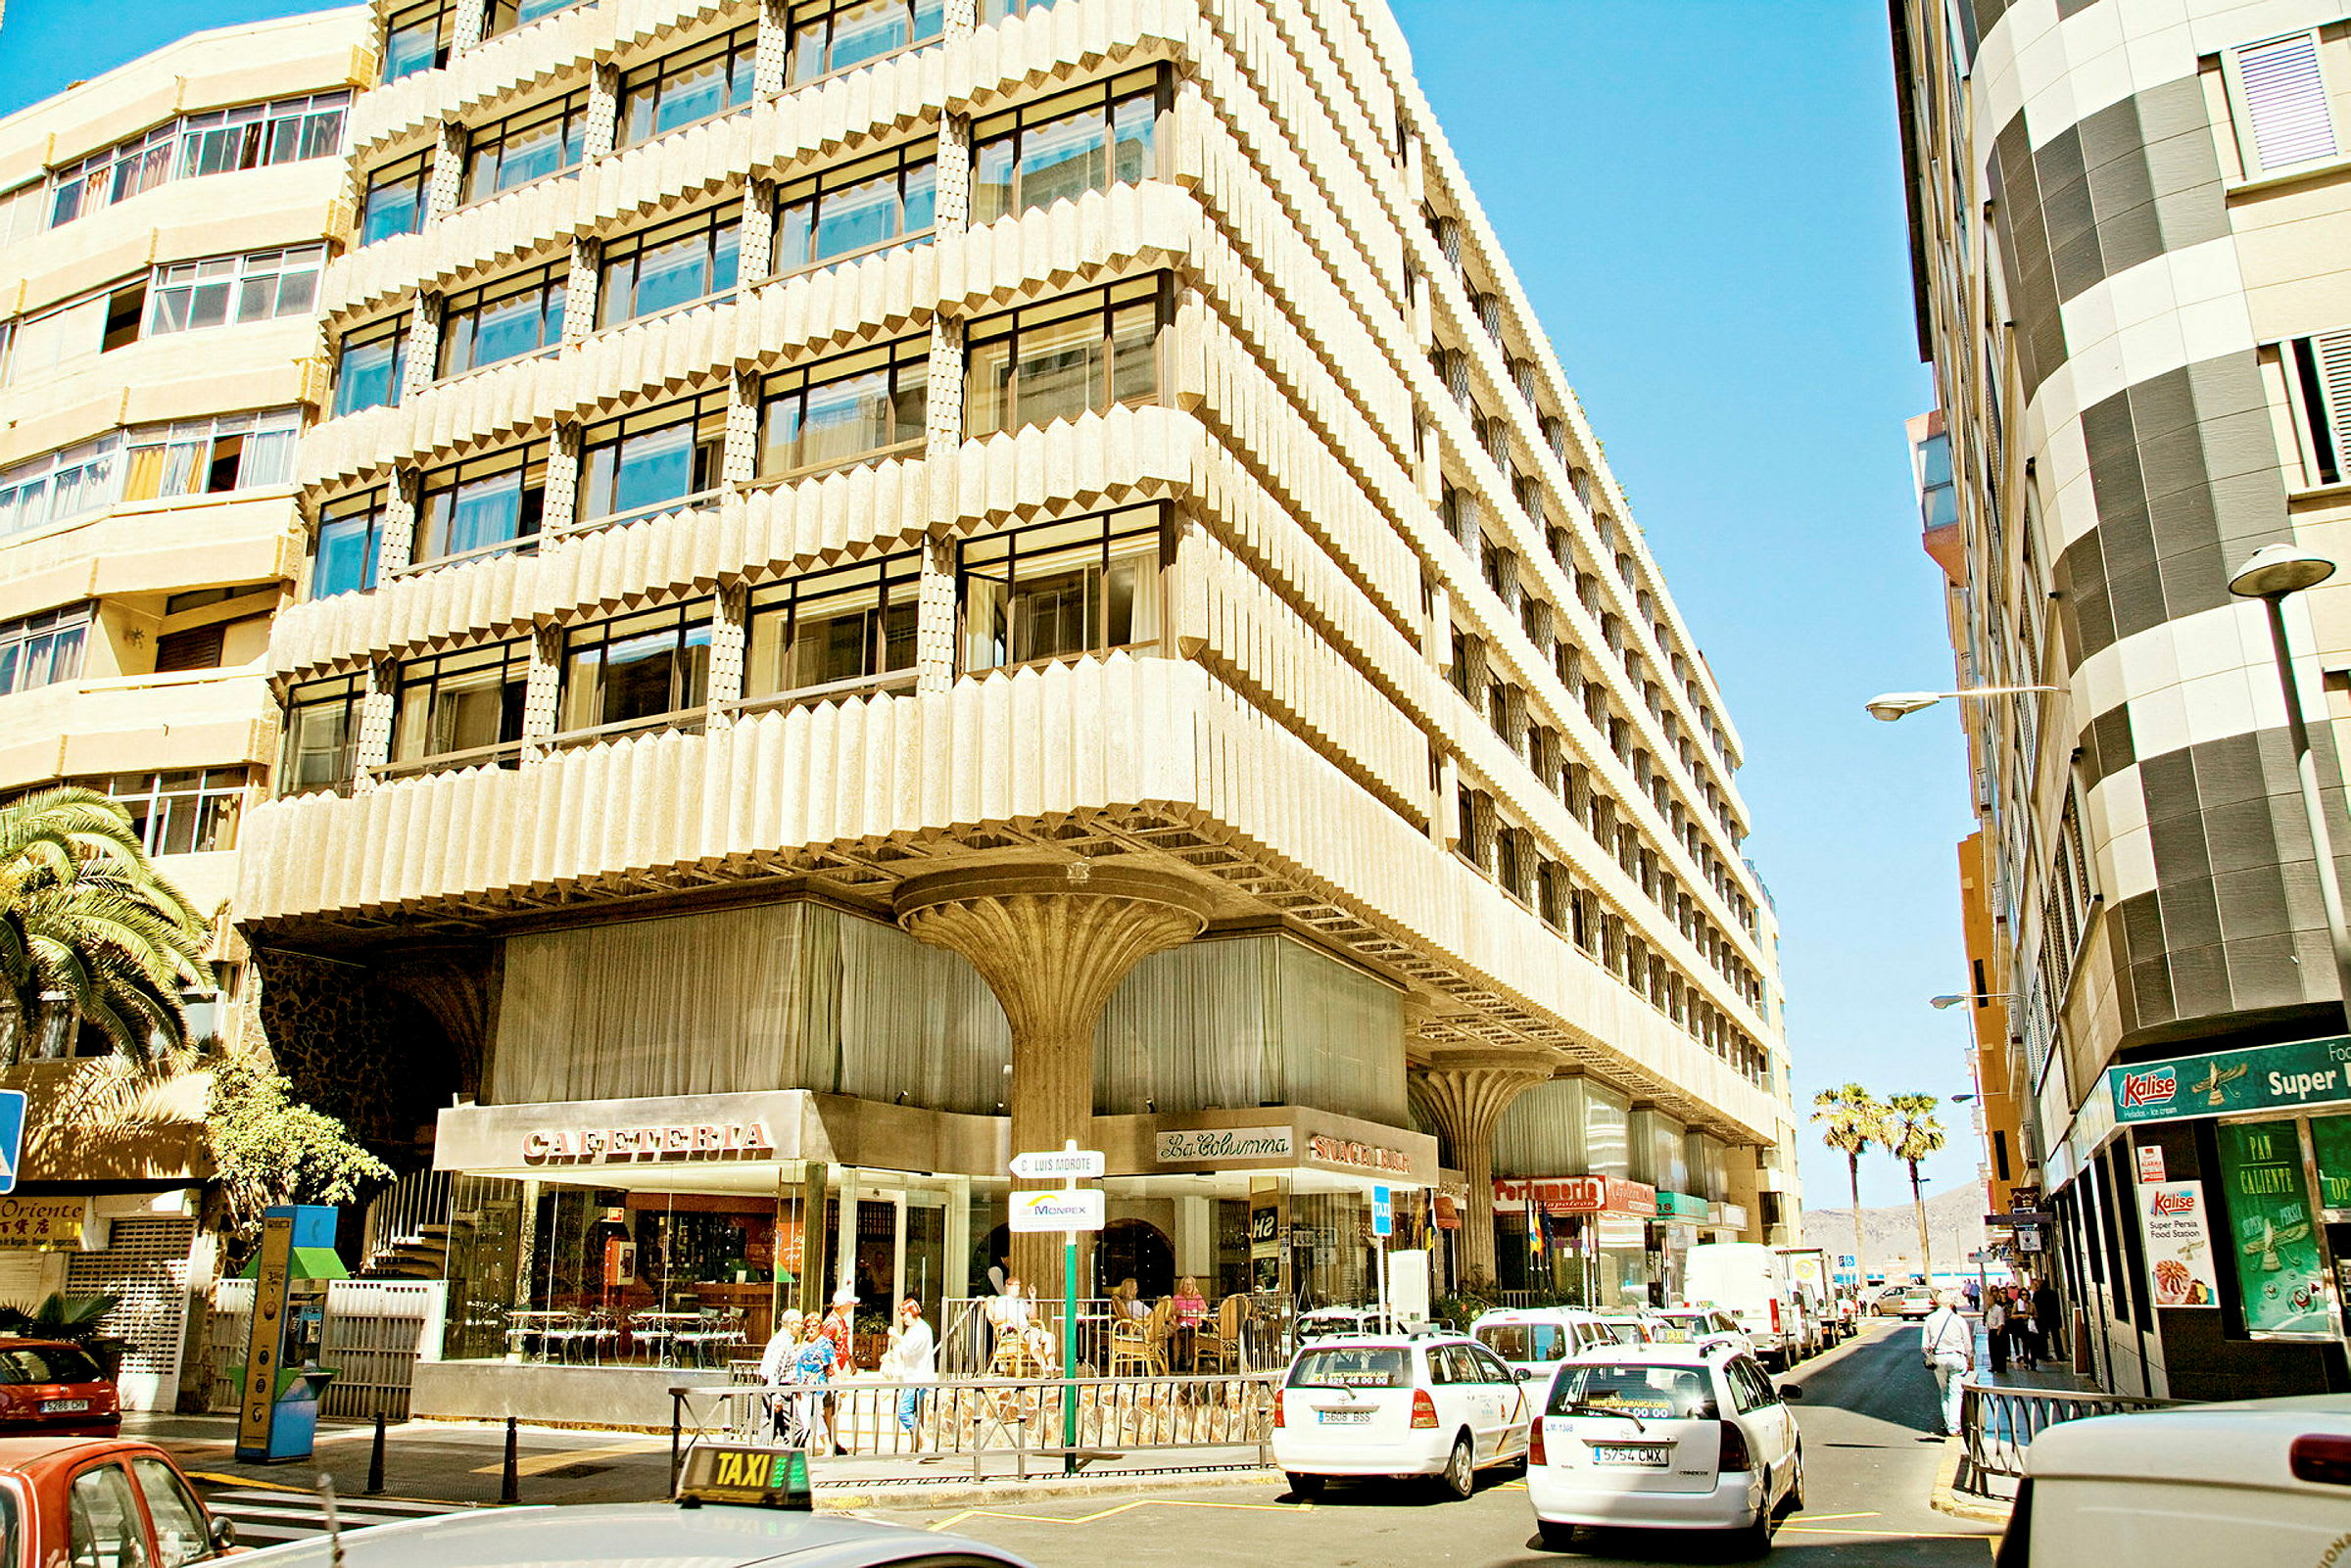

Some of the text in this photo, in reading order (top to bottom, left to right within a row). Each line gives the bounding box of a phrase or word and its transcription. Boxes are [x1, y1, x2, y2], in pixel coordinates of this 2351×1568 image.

[2125, 1073, 2176, 1107] Kalise
[2268, 1070, 2337, 1100] Super
[523, 1123, 771, 1164] CAFETERIA
[1160, 1134, 1194, 1158] La
[1314, 1135, 1371, 1166] SNACK
[2249, 1135, 2273, 1161] PAN
[1034, 1159, 1053, 1171] LUIS
[1055, 1158, 1090, 1170] MOROTE
[2239, 1168, 2294, 1194] CALIENTE
[2, 1199, 82, 1217] Oriente
[1374, 1202, 1390, 1216] TAXI
[2153, 1191, 2195, 1215] Kalise
[2150, 1221, 2171, 1230] Super
[2173, 1229, 2200, 1238] Station
[1652, 1408, 1668, 1418] 00
[1604, 1449, 1662, 1462] 5754 CMX
[716, 1451, 771, 1487] TAXI
